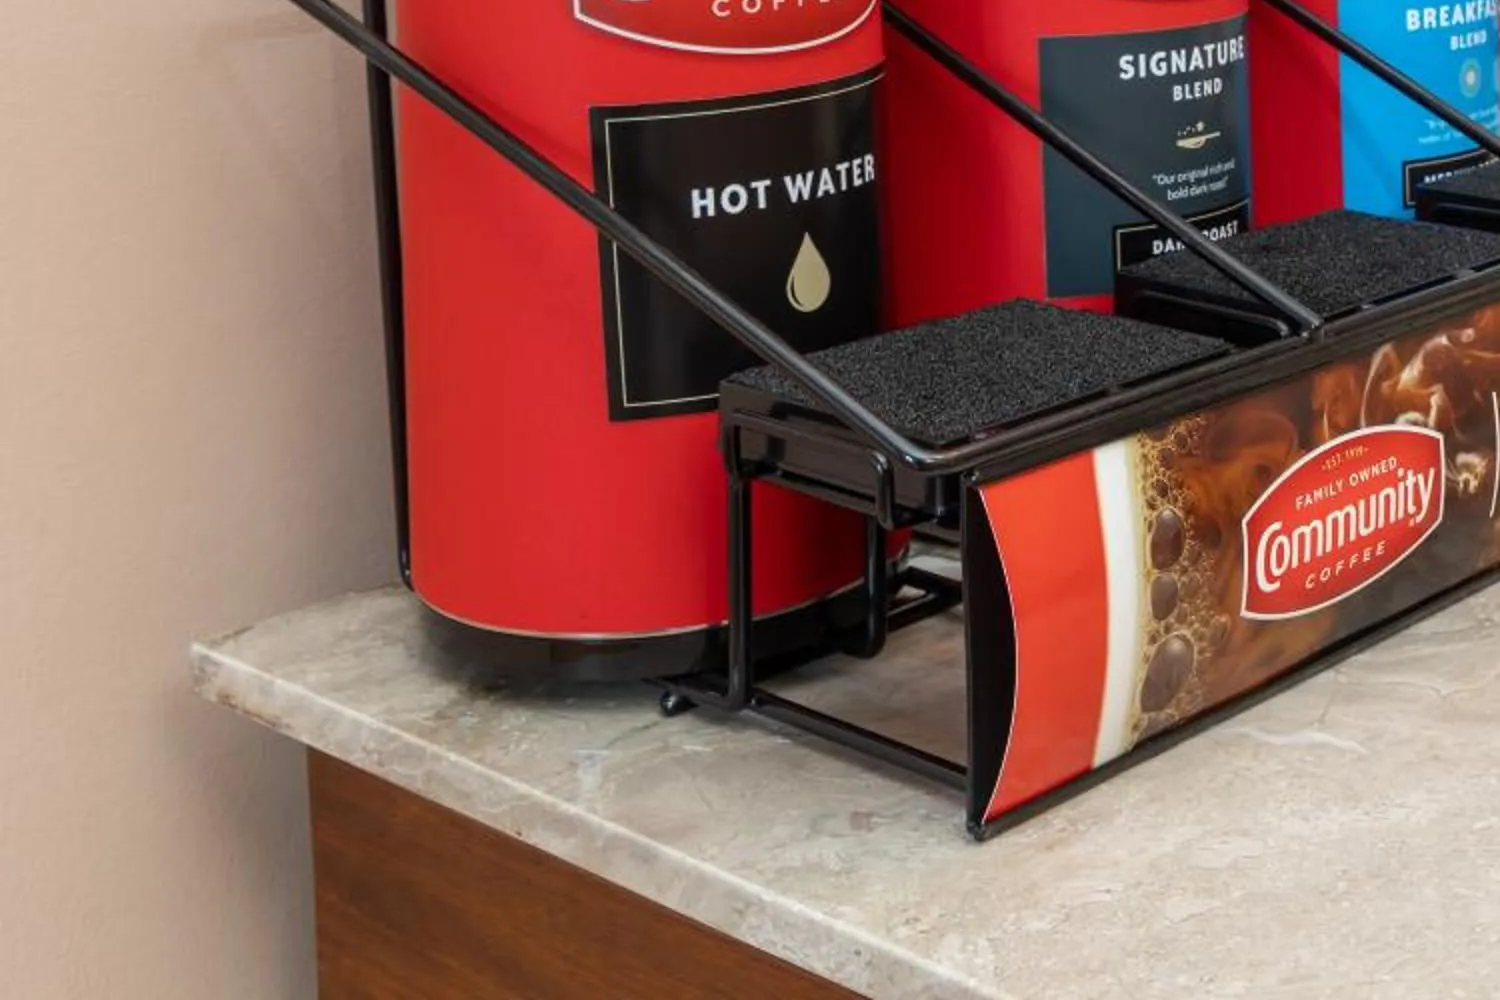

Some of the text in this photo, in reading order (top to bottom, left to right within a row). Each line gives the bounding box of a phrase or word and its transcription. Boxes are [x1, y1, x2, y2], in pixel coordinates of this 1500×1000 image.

[1119, 35, 1244, 80] SIGNATURE
[1450, 28, 1487, 51] BLEND
[1173, 77, 1224, 102] BLEND
[691, 153, 875, 219] HOT WATER
[1295, 455, 1397, 512] FAMILY OWNED
[1256, 467, 1436, 593] Community
[1304, 540, 1387, 590] COFFEE
